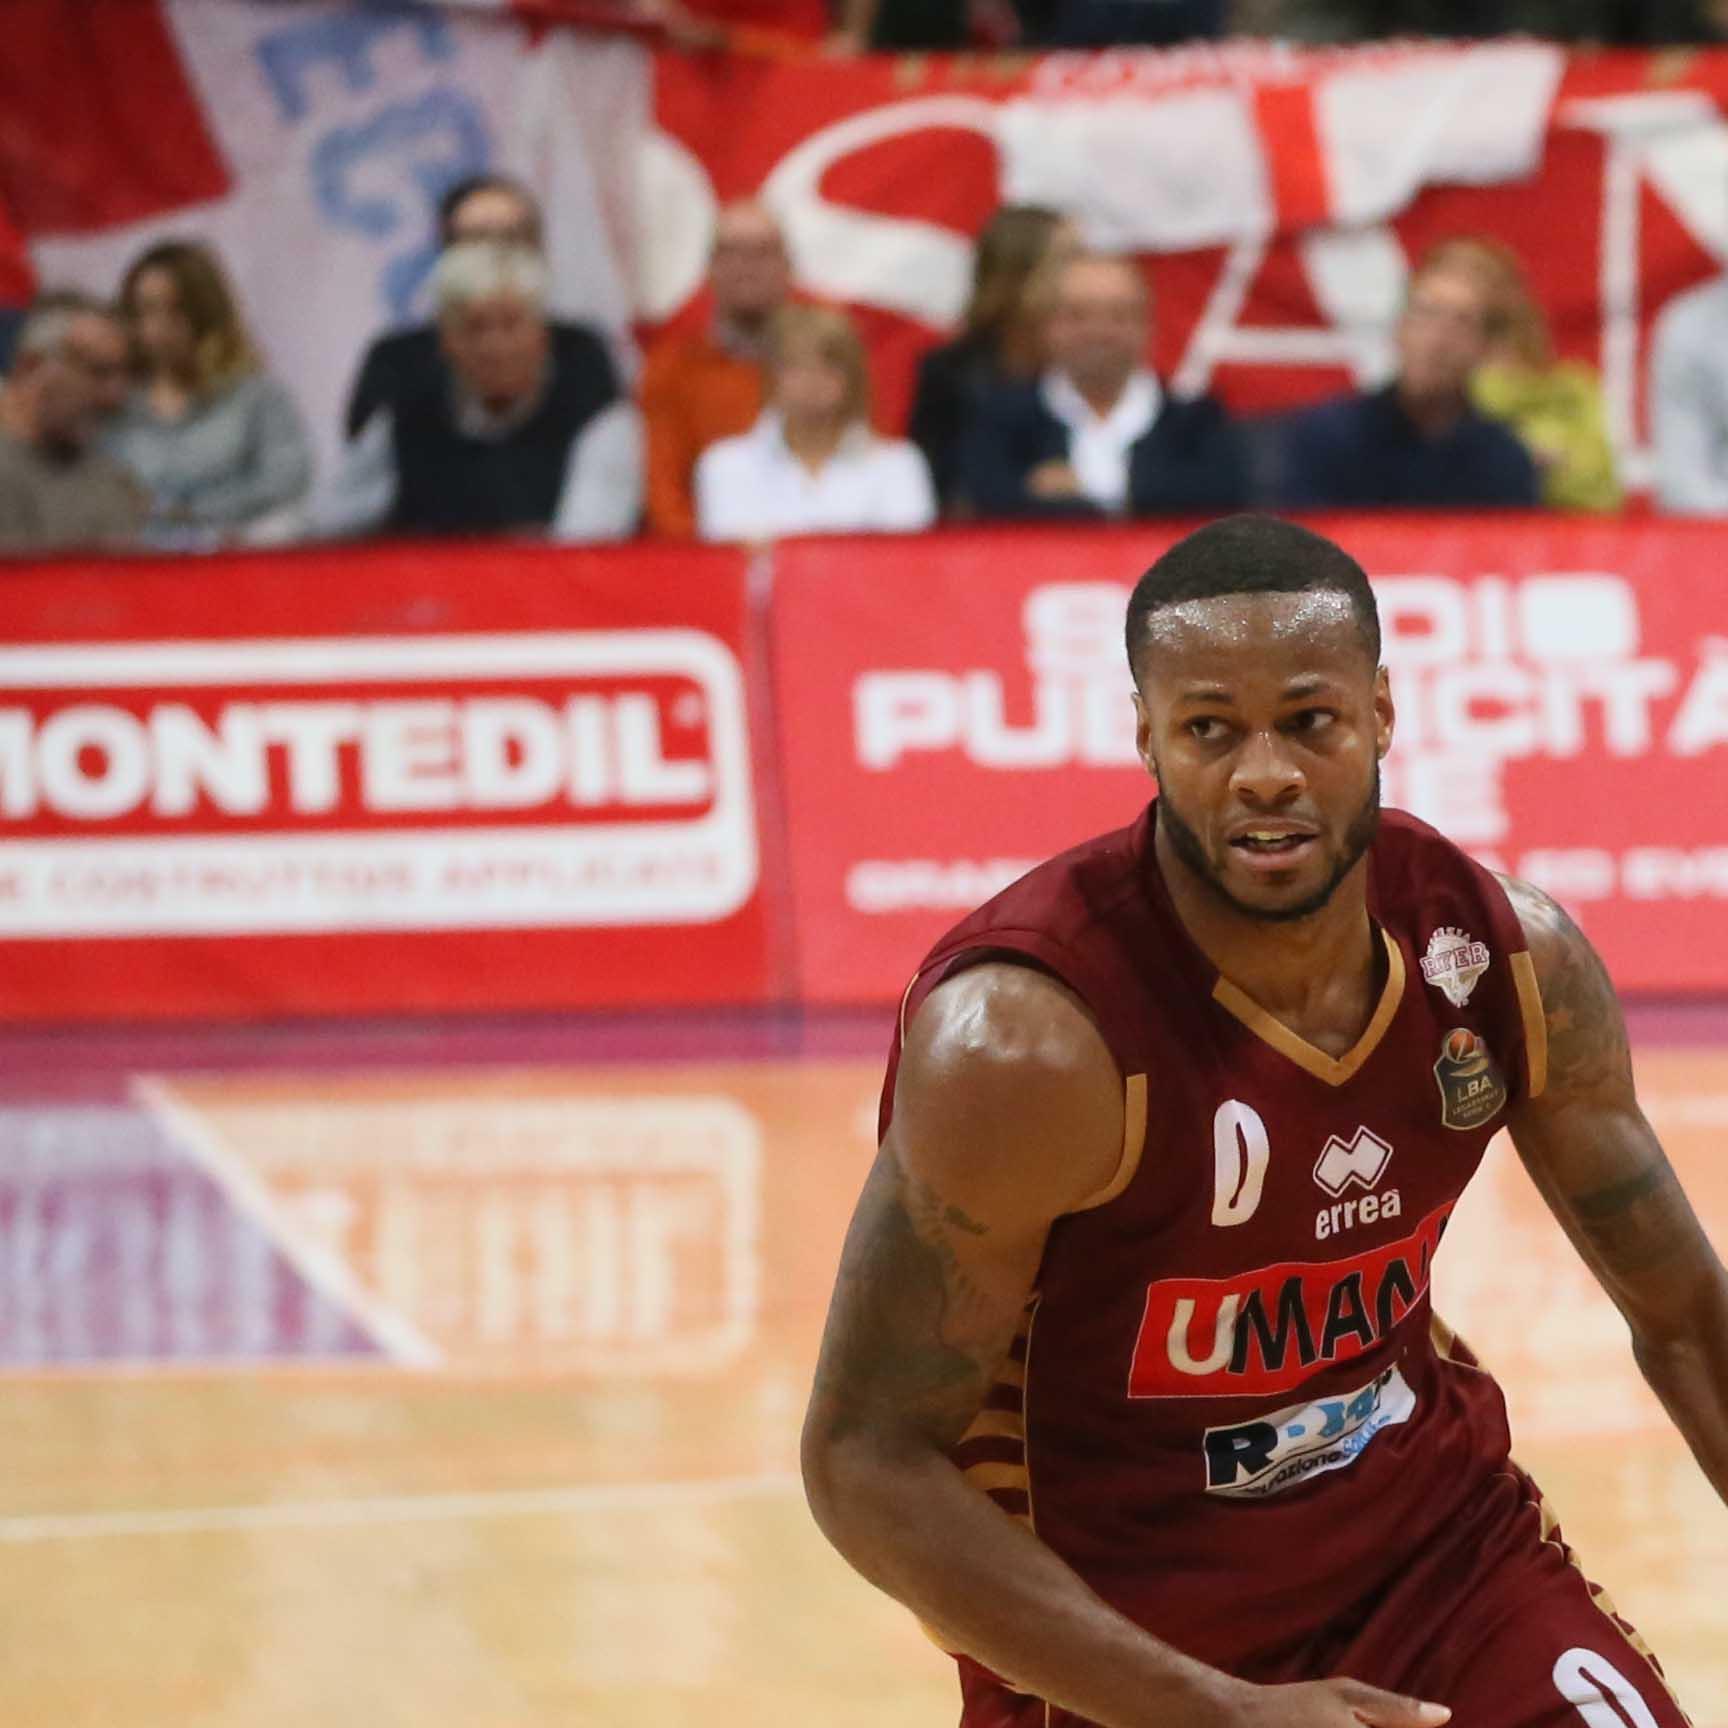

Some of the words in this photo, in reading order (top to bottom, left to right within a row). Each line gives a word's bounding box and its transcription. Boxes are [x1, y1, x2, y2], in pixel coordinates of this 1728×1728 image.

[1022, 580, 1642, 668] SDIO
[1457, 1075, 1493, 1103] LBA
[1167, 1235, 1436, 1376] UMAN
